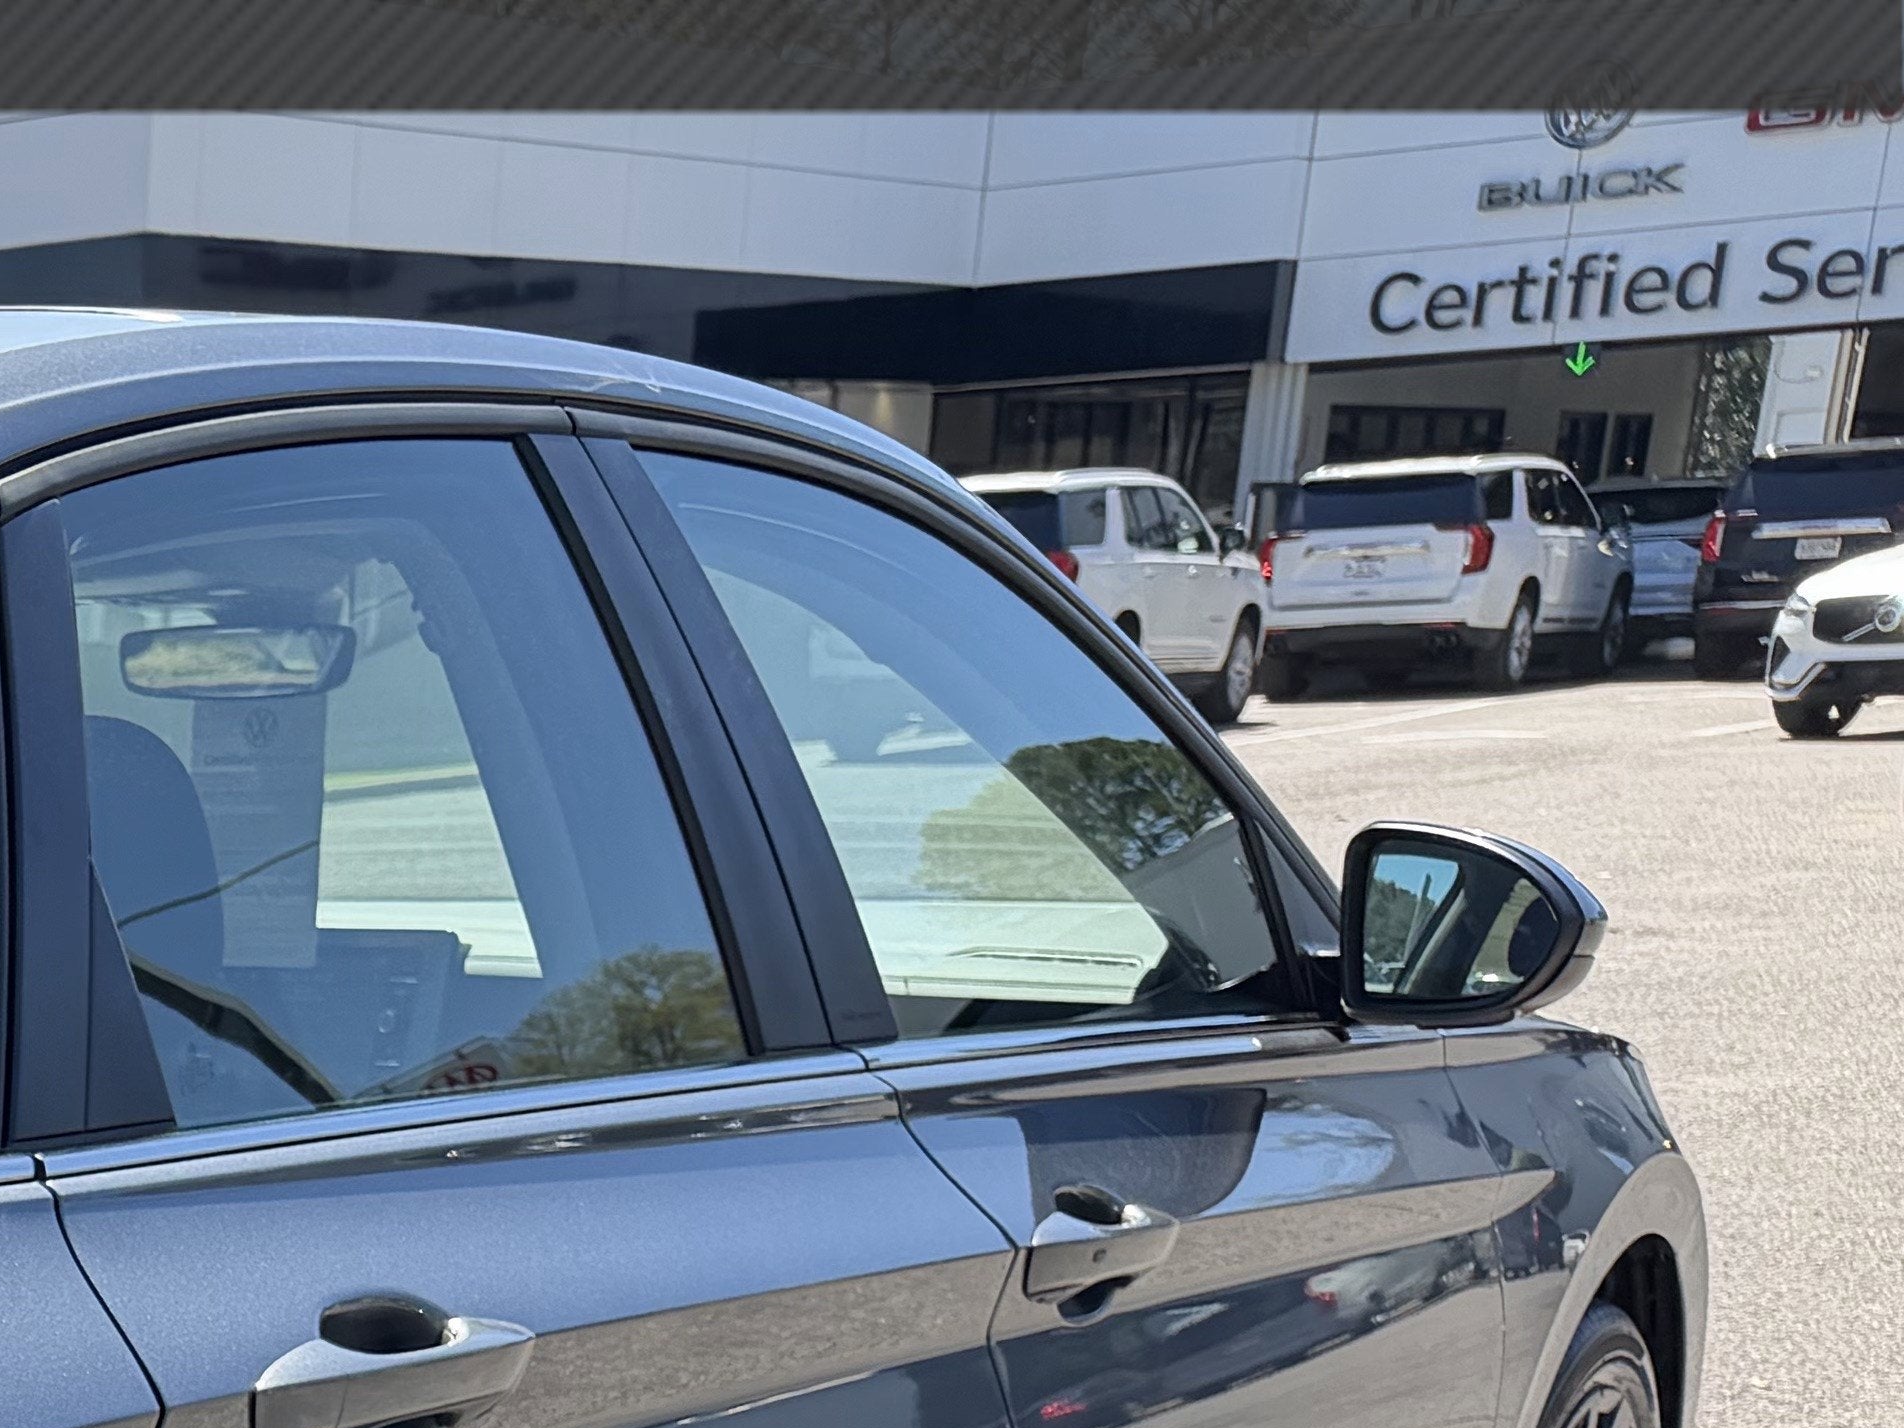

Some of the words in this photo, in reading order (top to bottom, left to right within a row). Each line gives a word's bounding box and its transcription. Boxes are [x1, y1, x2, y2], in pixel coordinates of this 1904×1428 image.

[1477, 162, 1686, 213] BUICK
[1368, 241, 1730, 336] Certified
[1758, 236, 1904, 305] Ser
